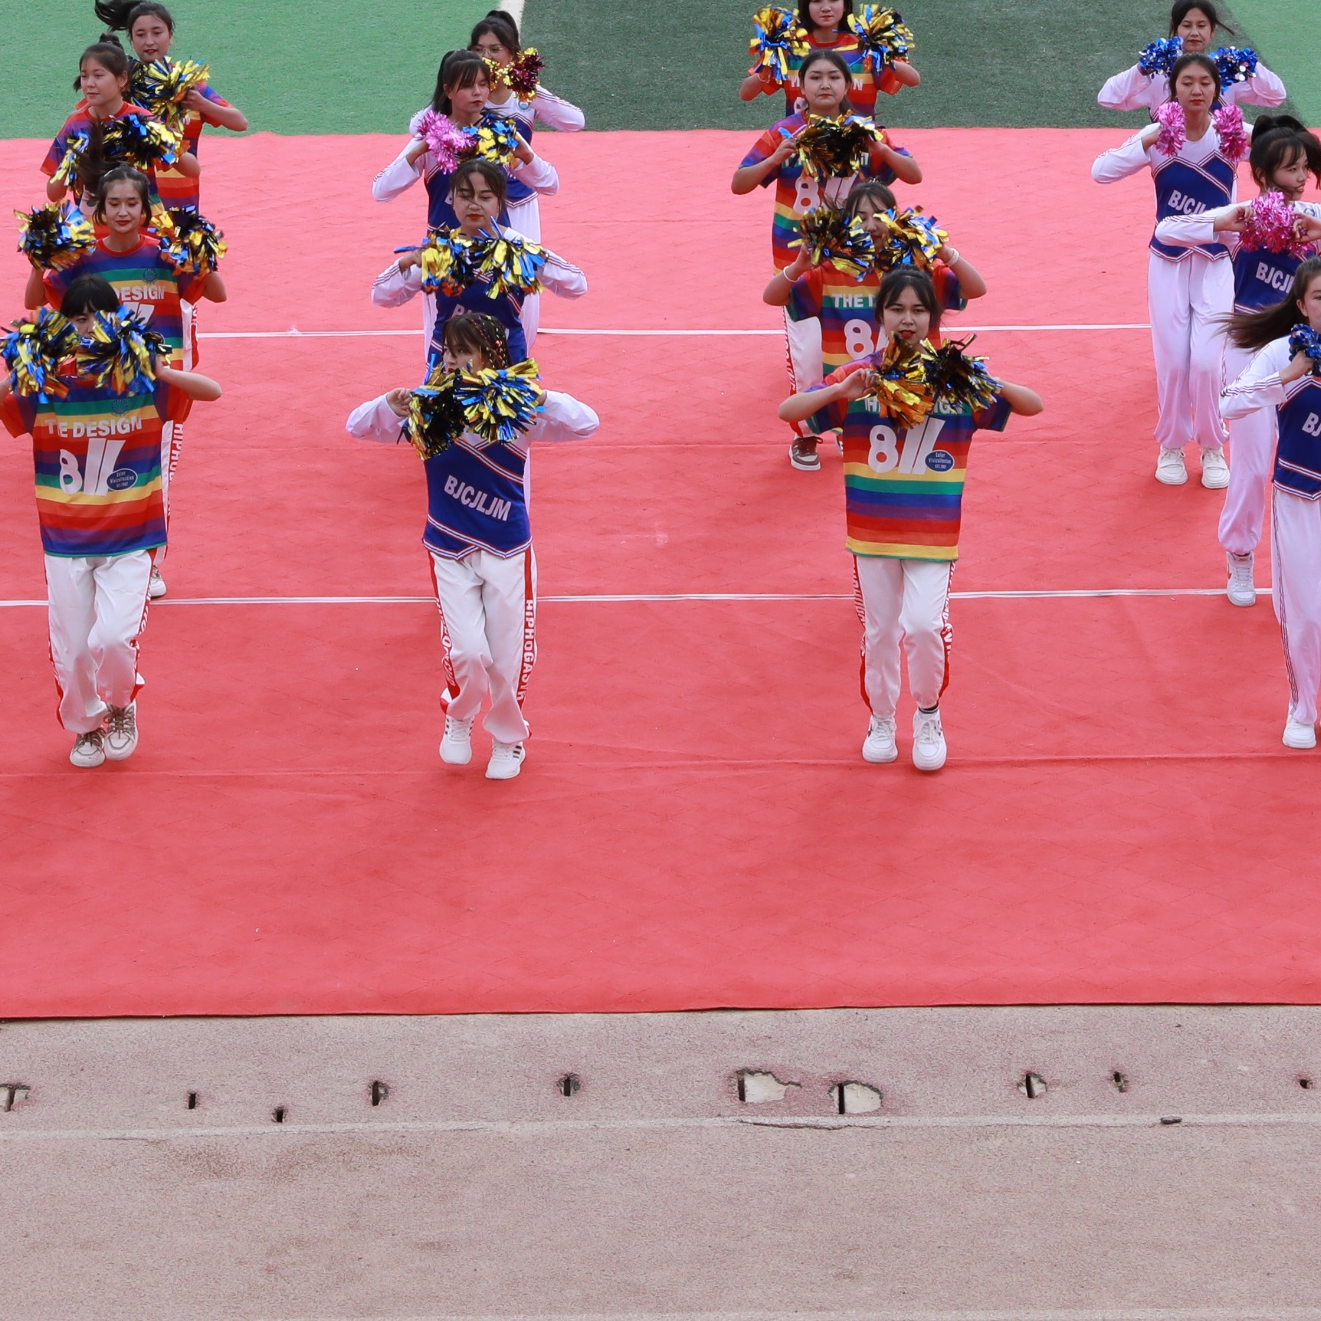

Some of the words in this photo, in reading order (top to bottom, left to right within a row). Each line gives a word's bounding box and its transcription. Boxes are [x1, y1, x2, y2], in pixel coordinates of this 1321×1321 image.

[832, 293, 863, 308] THE
[73, 415, 143, 438] DESIGN
[444, 475, 512, 522] BJCJLJM
